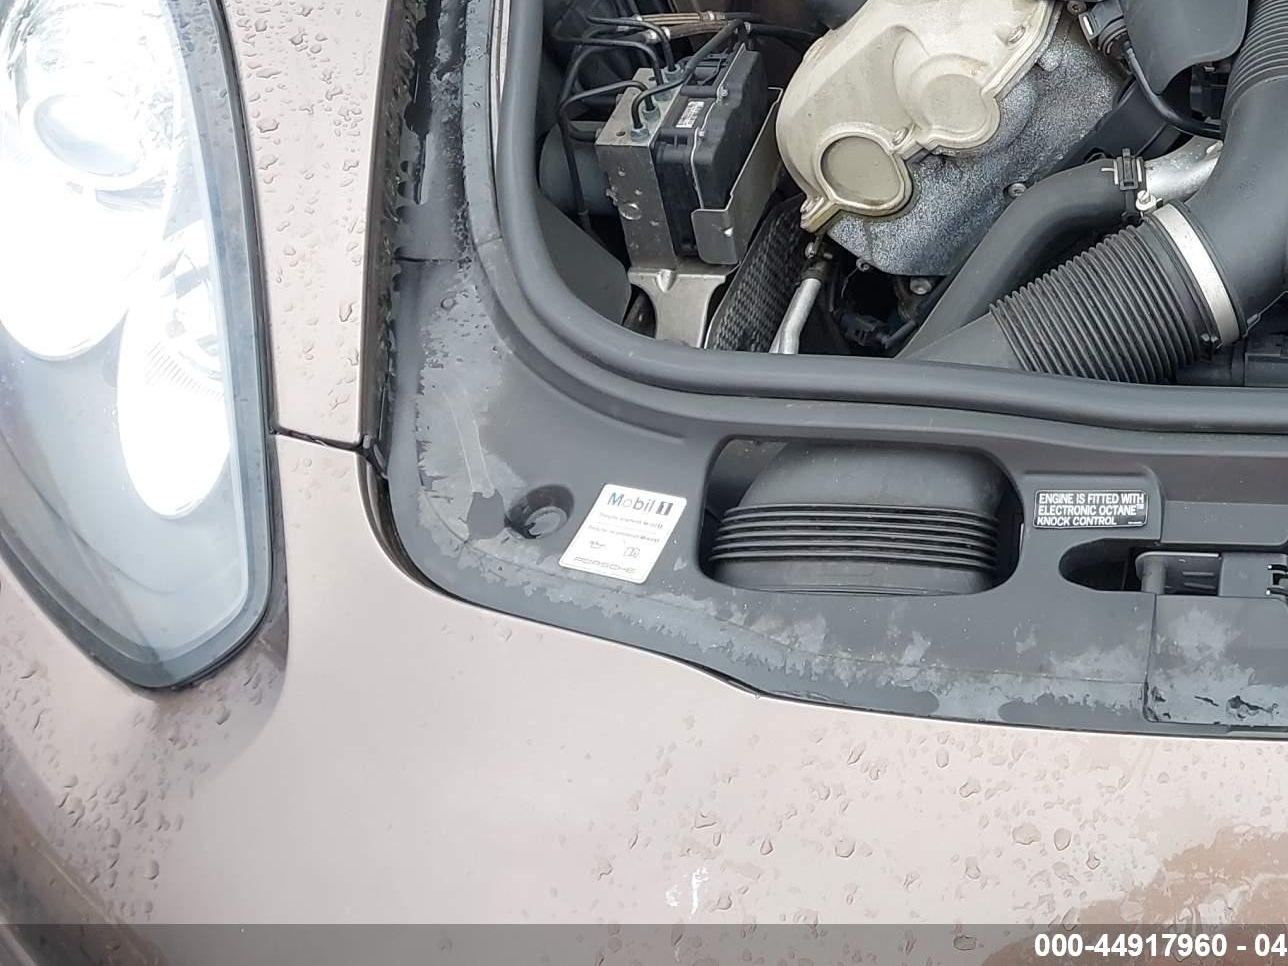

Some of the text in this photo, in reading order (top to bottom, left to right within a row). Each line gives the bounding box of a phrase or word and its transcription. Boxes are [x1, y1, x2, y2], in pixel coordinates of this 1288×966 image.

[607, 492, 674, 516] Mobil 1
[1039, 493, 1145, 504] ENGINE IS FITTED WITH
[1038, 504, 1097, 516] ELECTRONIC
[1036, 516, 1118, 526] KNOCK CONTROL
